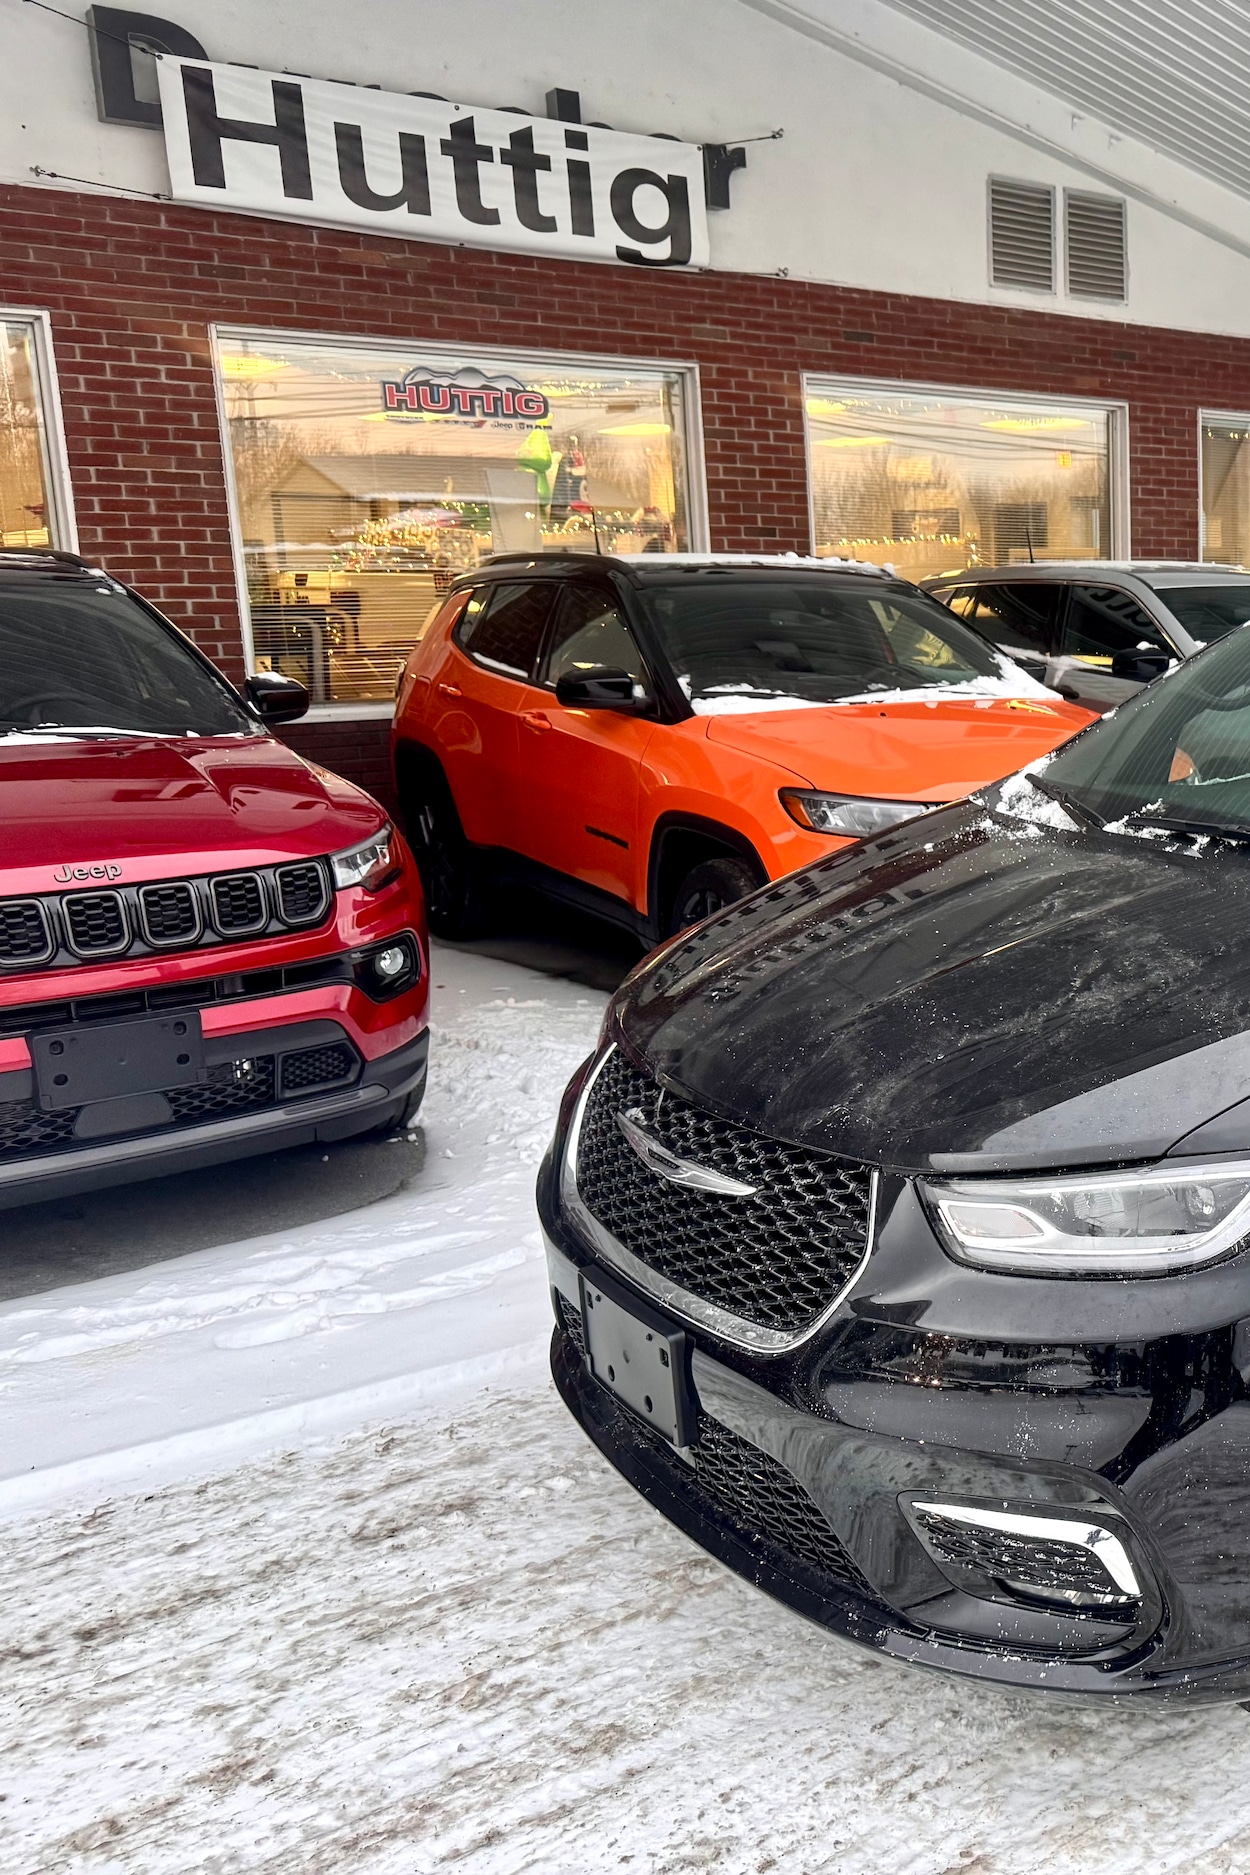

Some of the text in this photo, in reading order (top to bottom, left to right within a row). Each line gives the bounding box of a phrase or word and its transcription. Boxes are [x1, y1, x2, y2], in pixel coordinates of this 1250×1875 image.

[180, 64, 692, 267] Huttig
[384, 382, 547, 417] HUTTIG
[494, 421, 513, 431] Jeep
[54, 863, 122, 883] Jeep
